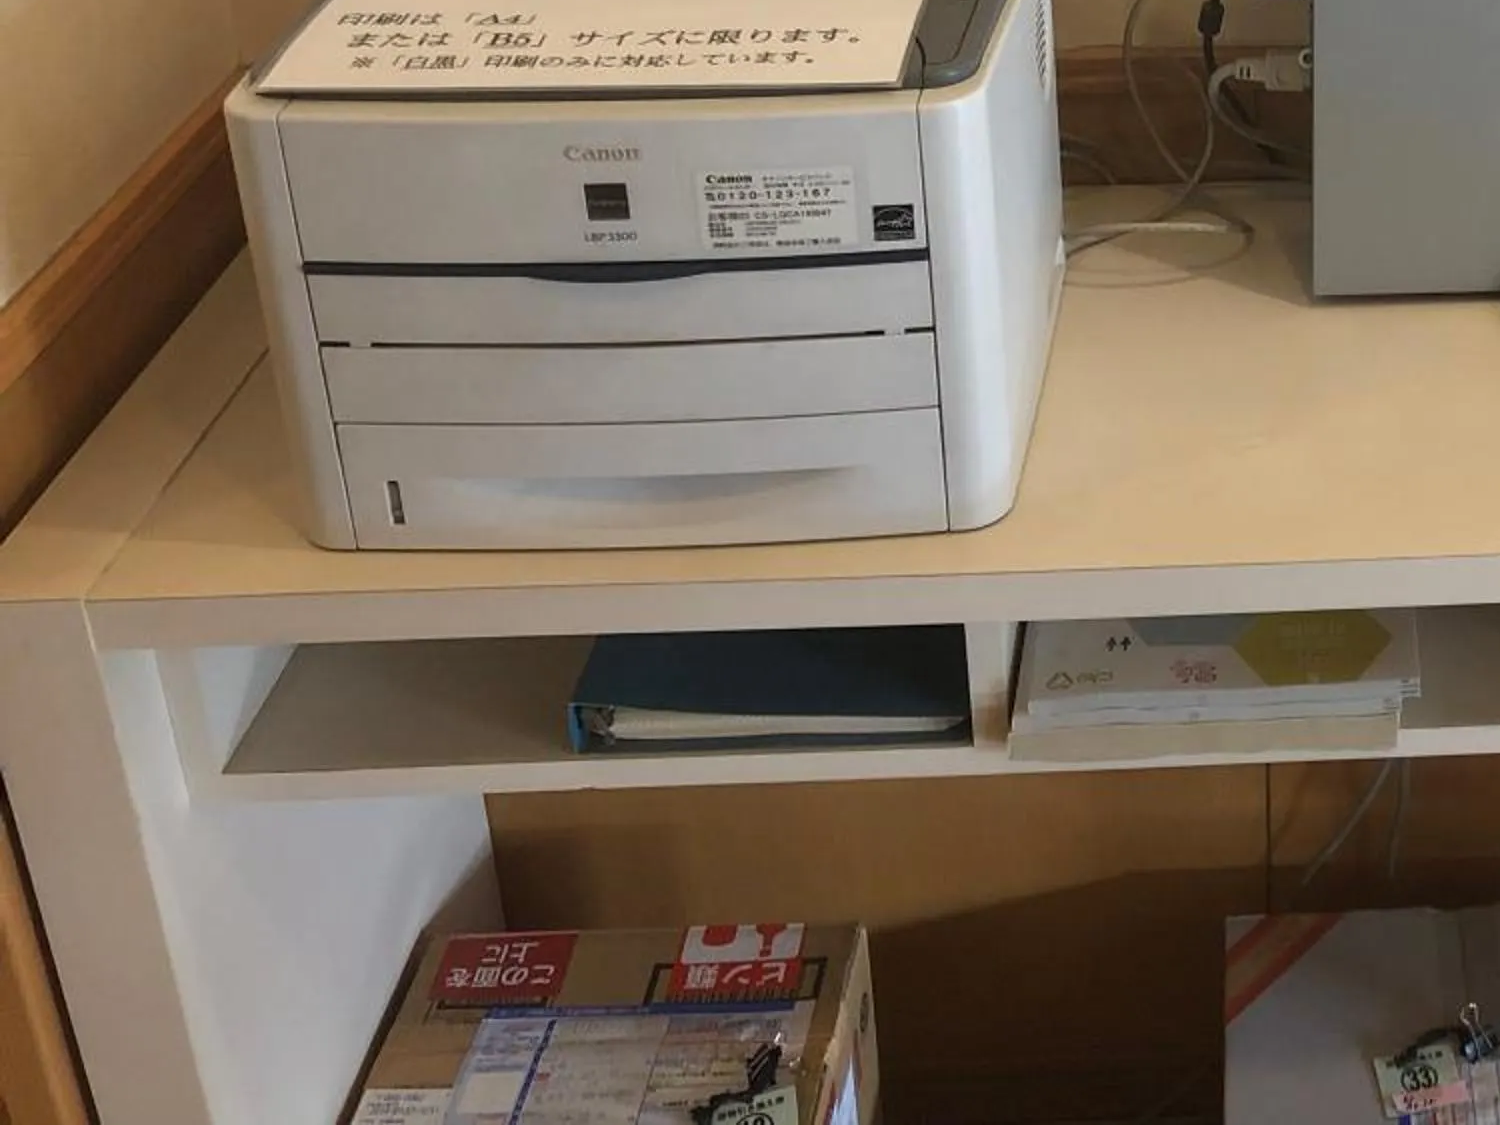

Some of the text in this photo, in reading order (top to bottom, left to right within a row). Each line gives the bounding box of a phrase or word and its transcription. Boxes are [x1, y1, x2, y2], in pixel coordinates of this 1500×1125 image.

[562, 144, 642, 162] Canon
[705, 174, 753, 185] Canon
[480, 941, 540, 963] 上に
[445, 964, 555, 987] この面を
[683, 962, 786, 989] ビン類
